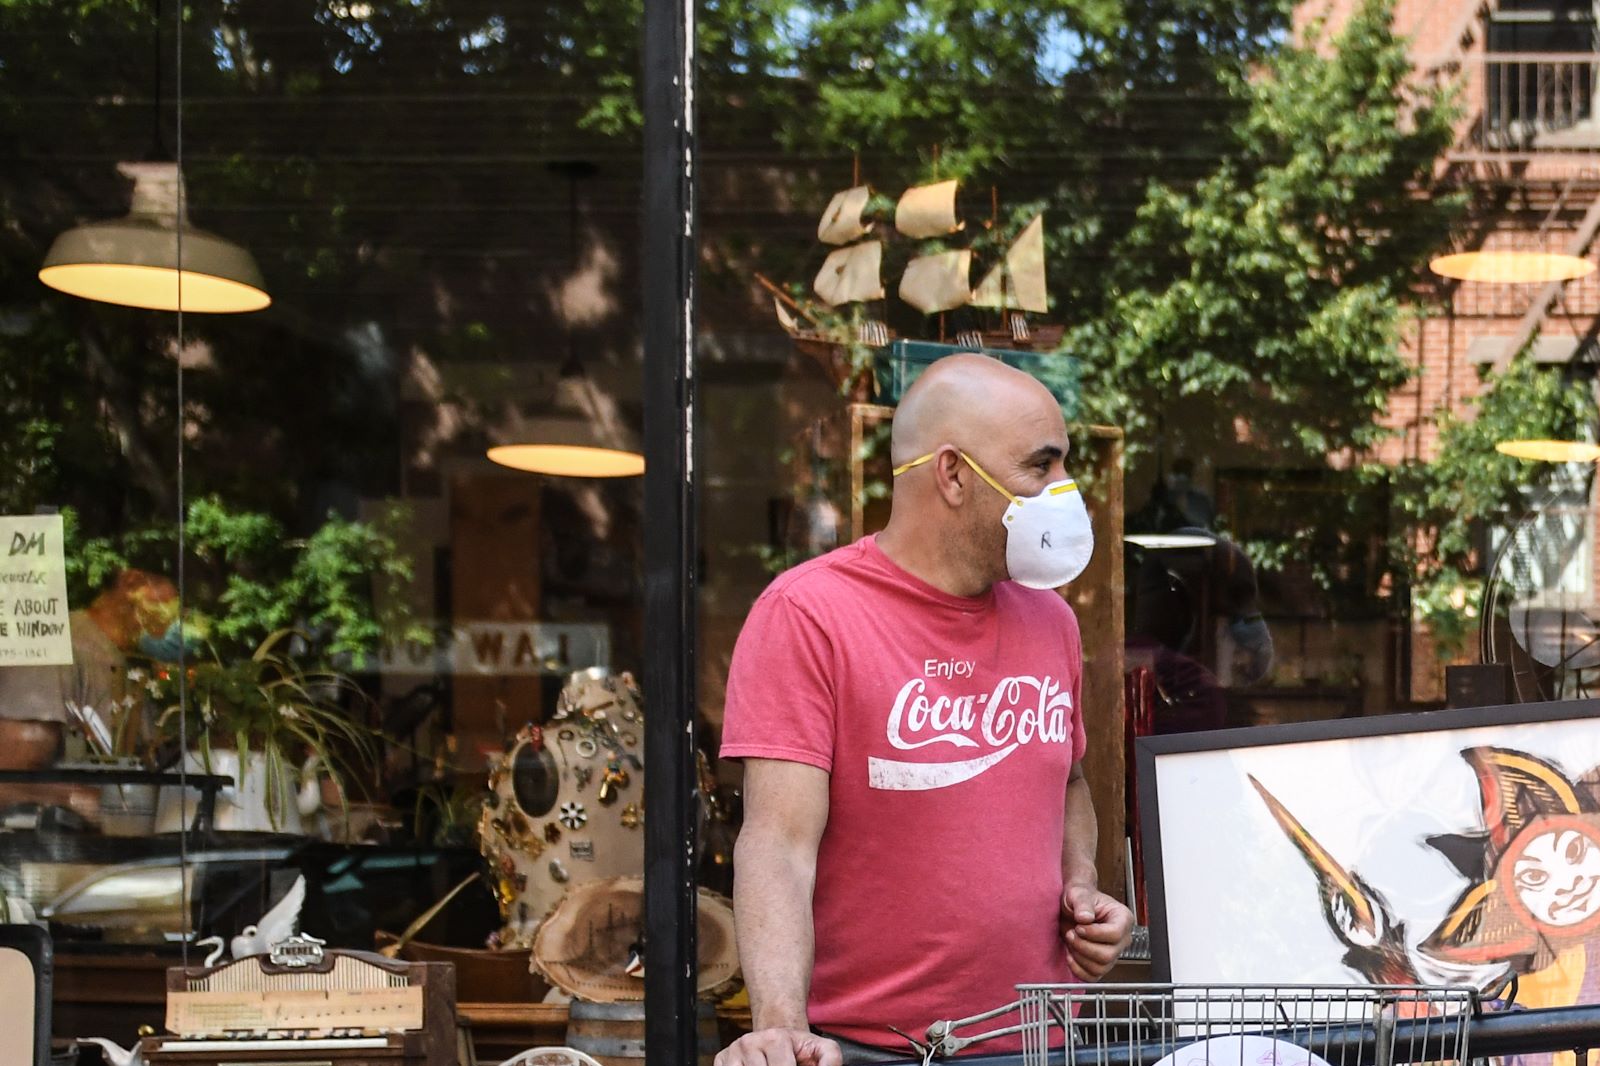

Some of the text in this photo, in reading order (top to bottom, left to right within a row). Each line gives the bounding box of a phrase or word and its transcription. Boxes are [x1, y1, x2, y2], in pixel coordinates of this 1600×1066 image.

[8, 531, 46, 556] DM
[1041, 531, 1052, 549] R
[14, 598, 59, 616] ABOUT
[16, 619, 65, 638] WINDOW
[924, 658, 976, 679] Enjoy
[886, 675, 1073, 750] Coca-Cola
